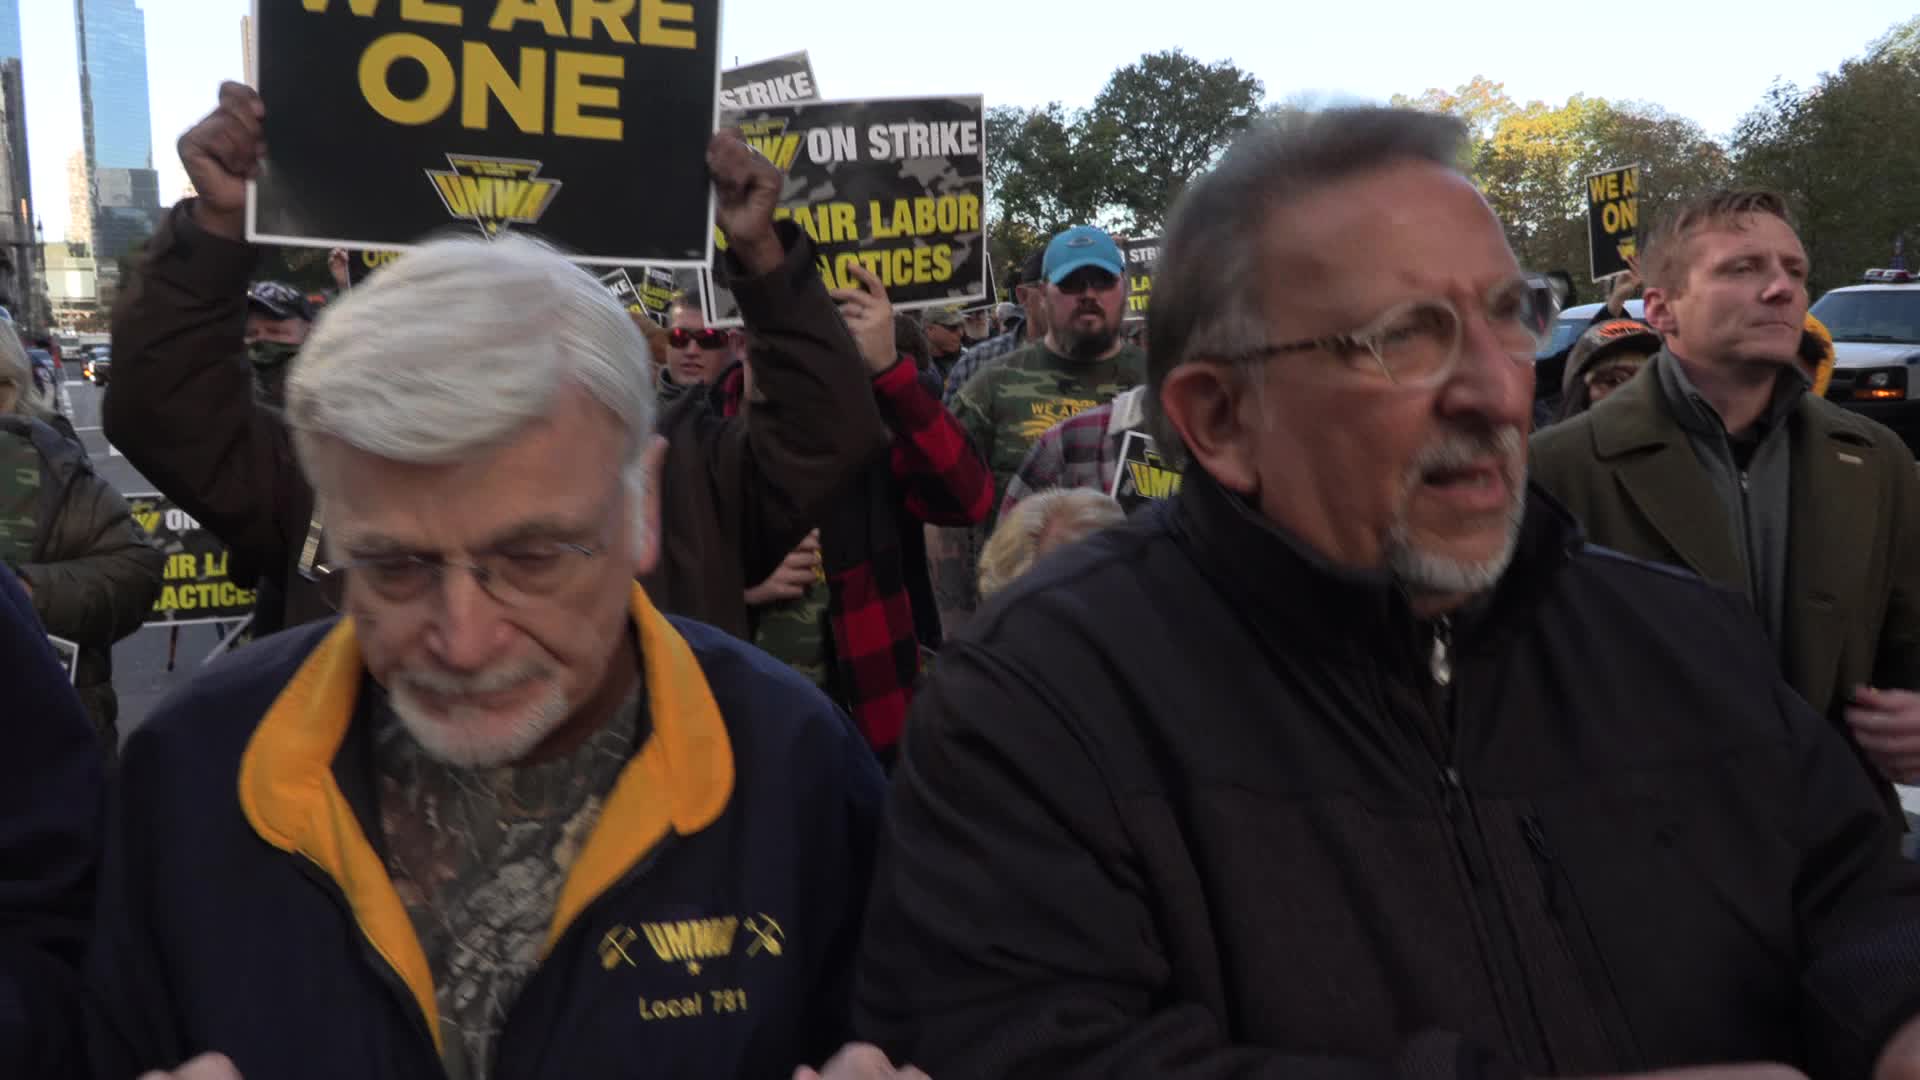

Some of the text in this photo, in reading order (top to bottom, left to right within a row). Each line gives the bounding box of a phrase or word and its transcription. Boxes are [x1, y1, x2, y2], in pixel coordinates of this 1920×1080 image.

[358, 32, 625, 141] ONE
[719, 71, 813, 107] STRIKE
[807, 126, 857, 165] ON
[868, 120, 978, 160] STRIKE
[1589, 172, 1619, 204] WE
[773, 195, 980, 244] AIR LABOR
[638, 987, 748, 1021] Local 781
